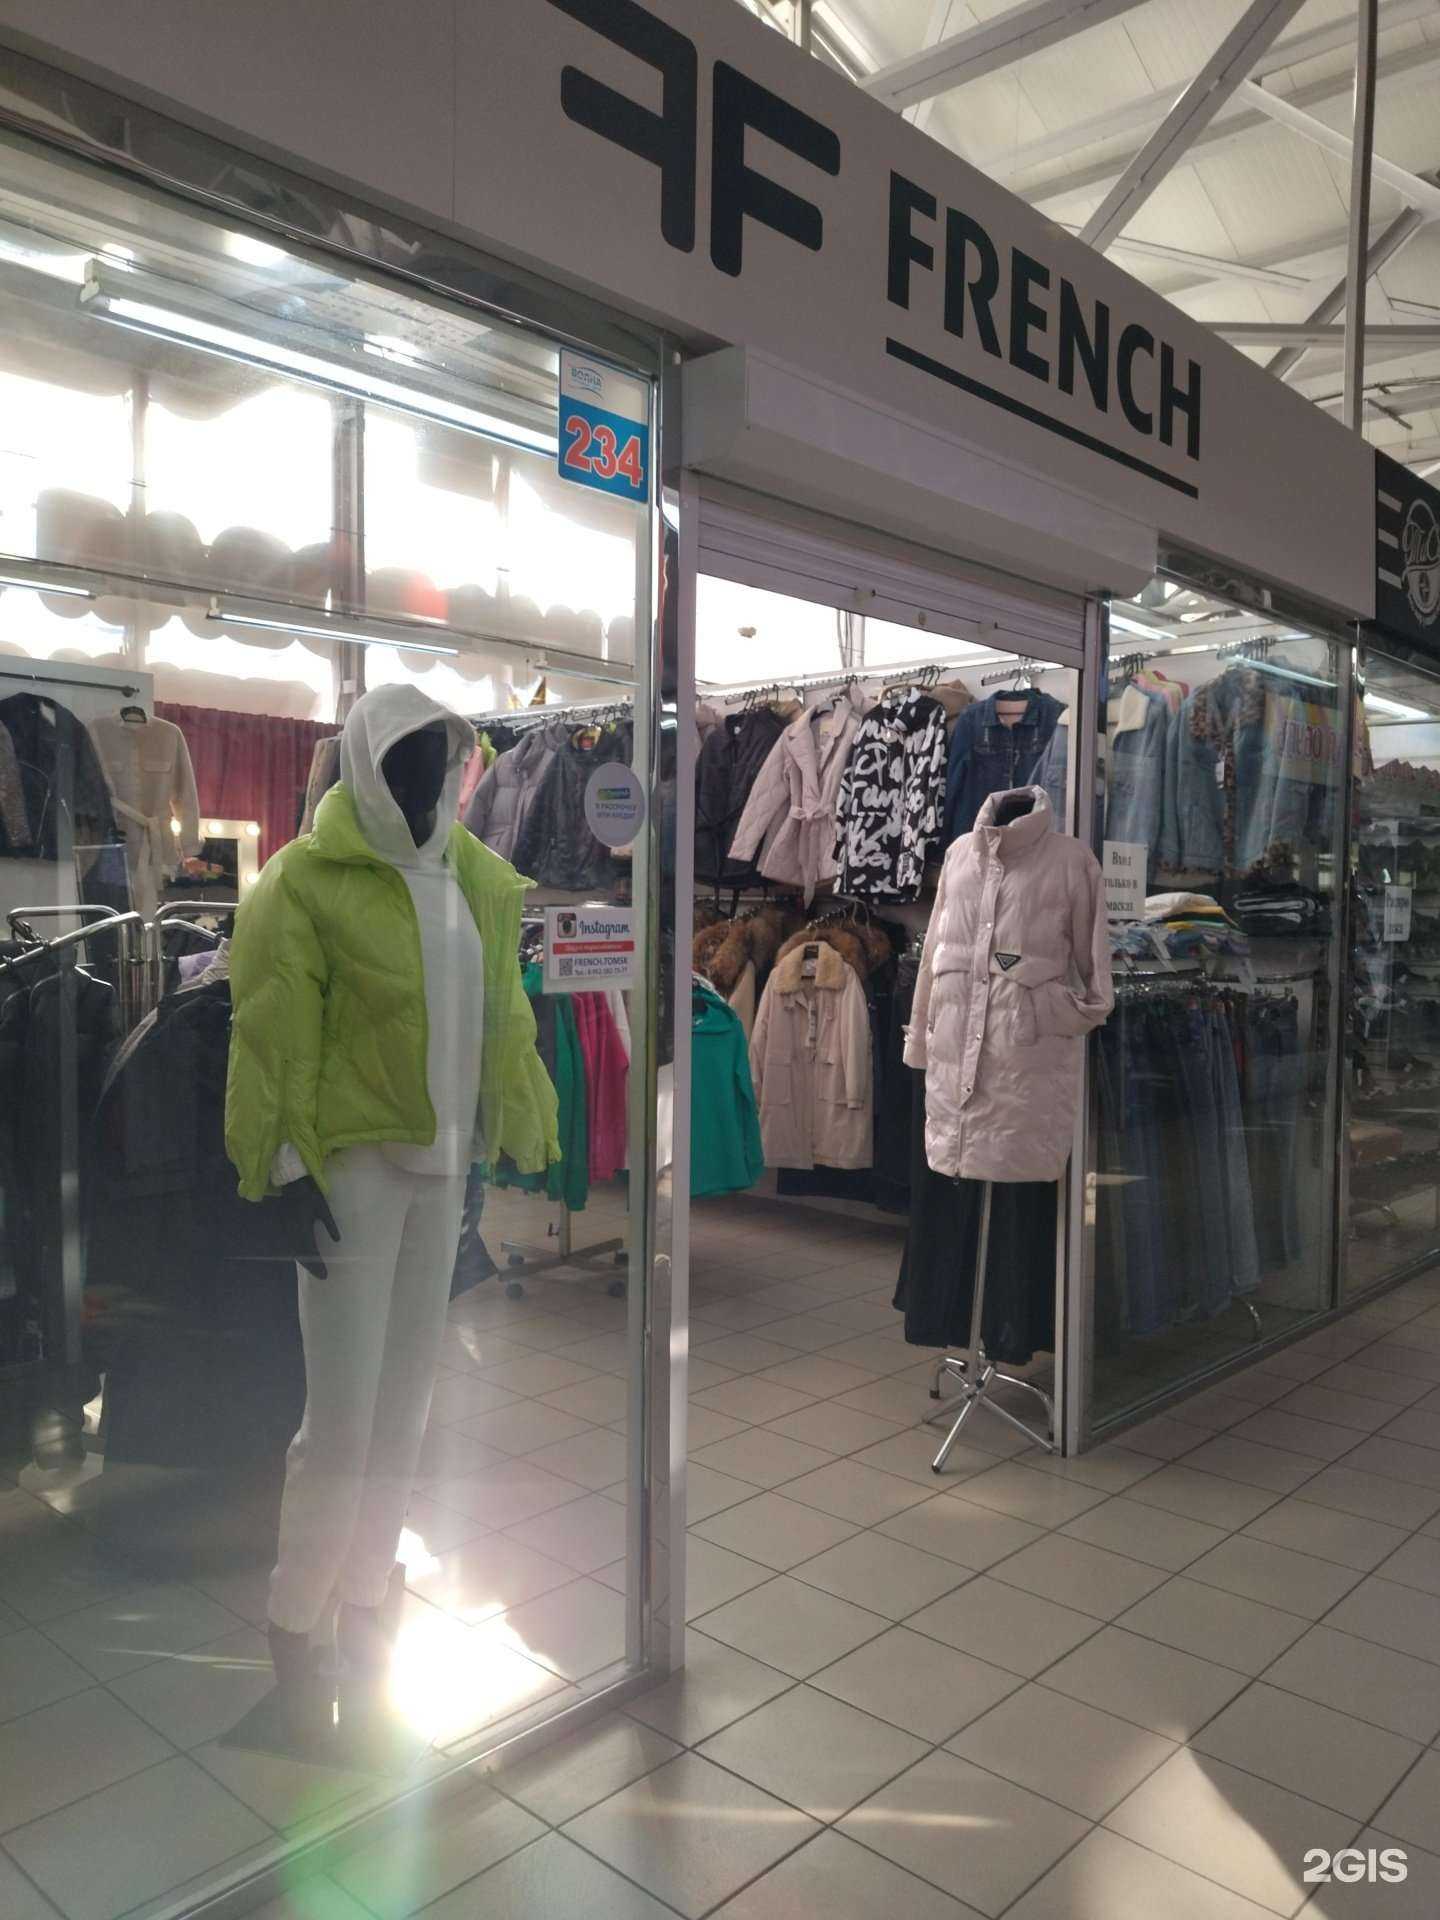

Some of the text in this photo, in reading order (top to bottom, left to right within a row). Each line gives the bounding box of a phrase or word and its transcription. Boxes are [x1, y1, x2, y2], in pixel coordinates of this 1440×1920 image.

[887, 169, 1202, 461] FRENCH
[565, 415, 643, 489] 234
[579, 919, 630, 939] Instagram
